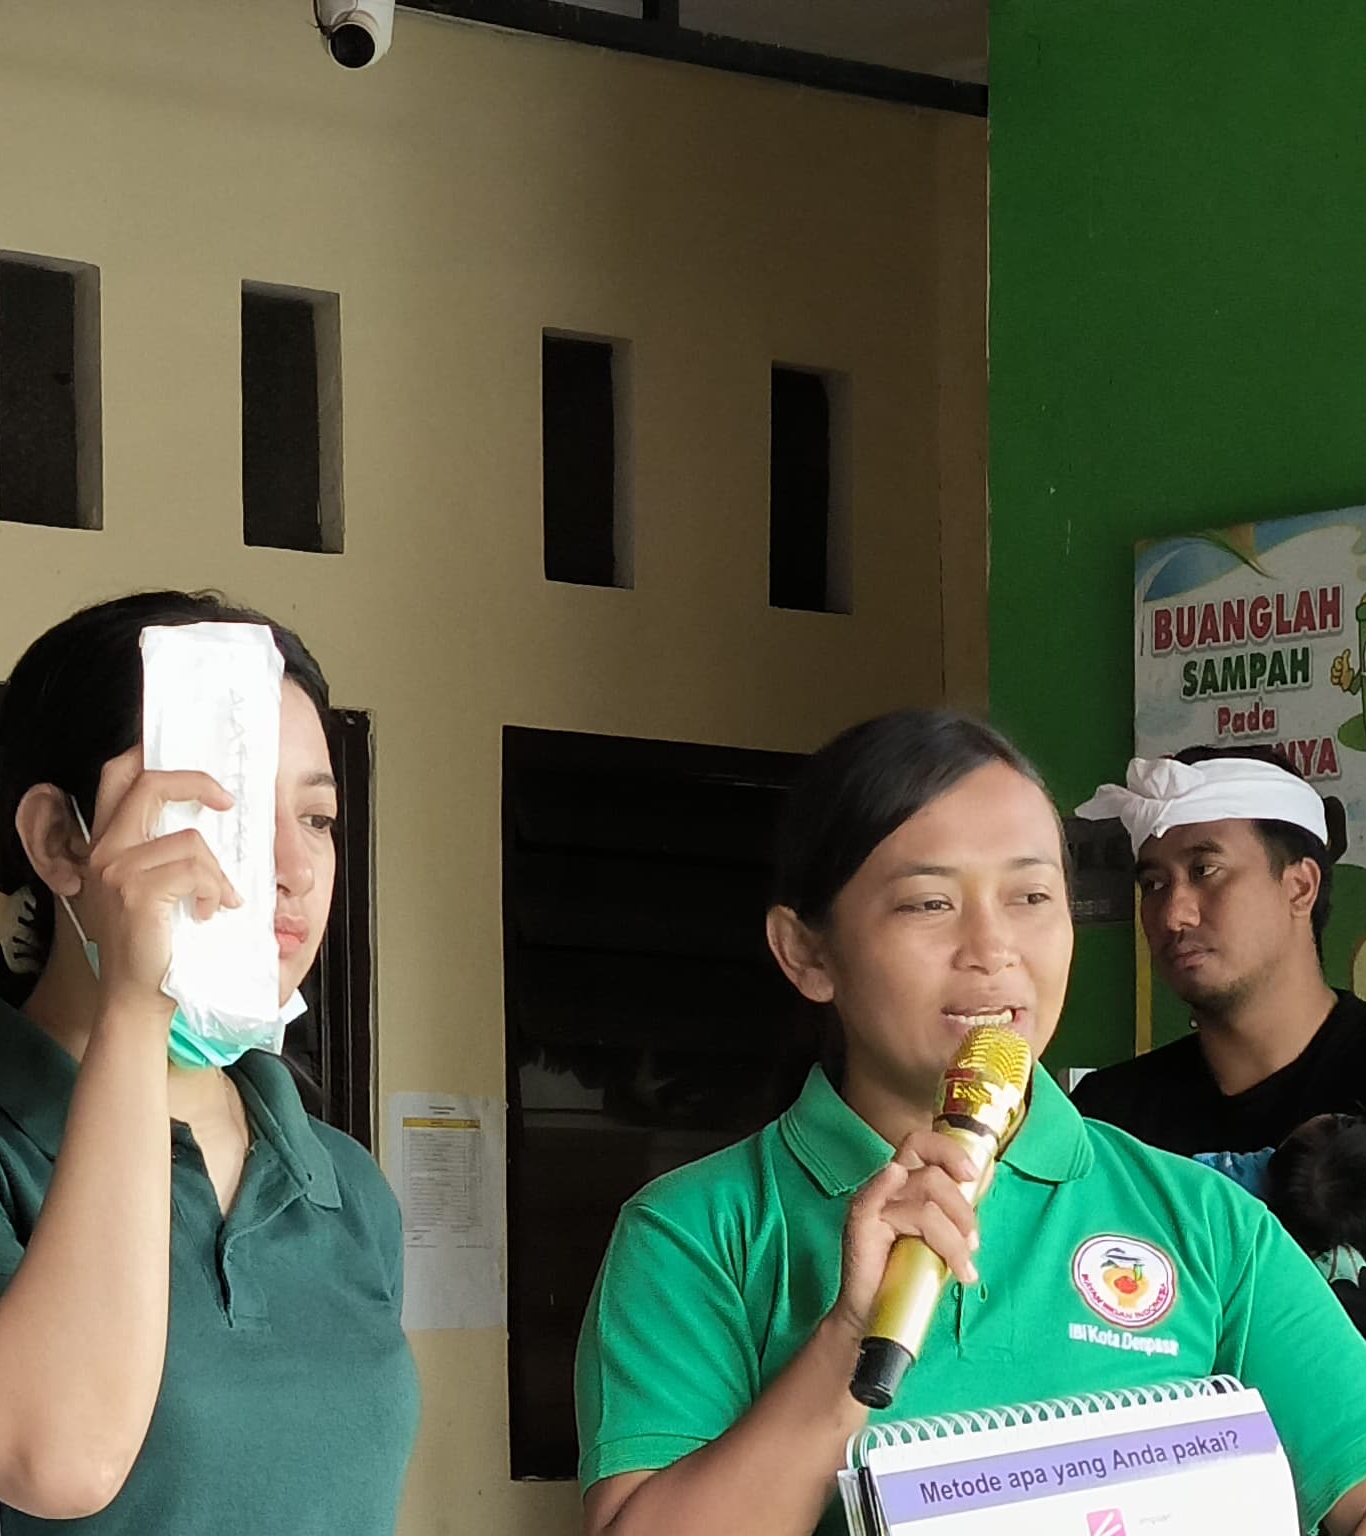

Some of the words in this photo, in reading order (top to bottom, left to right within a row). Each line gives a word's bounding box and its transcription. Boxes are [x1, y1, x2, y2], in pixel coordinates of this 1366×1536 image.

[1153, 585, 1342, 651] BUANGLAH
[1181, 647, 1311, 697] SAMPAH
[1217, 704, 1276, 735] Pada
[919, 1474, 1003, 1504] Metode
[1009, 1467, 1047, 1492] apa
[1052, 1456, 1107, 1485] yang
[1112, 1444, 1168, 1470] Anda
[1172, 1430, 1239, 1463] pakai?
